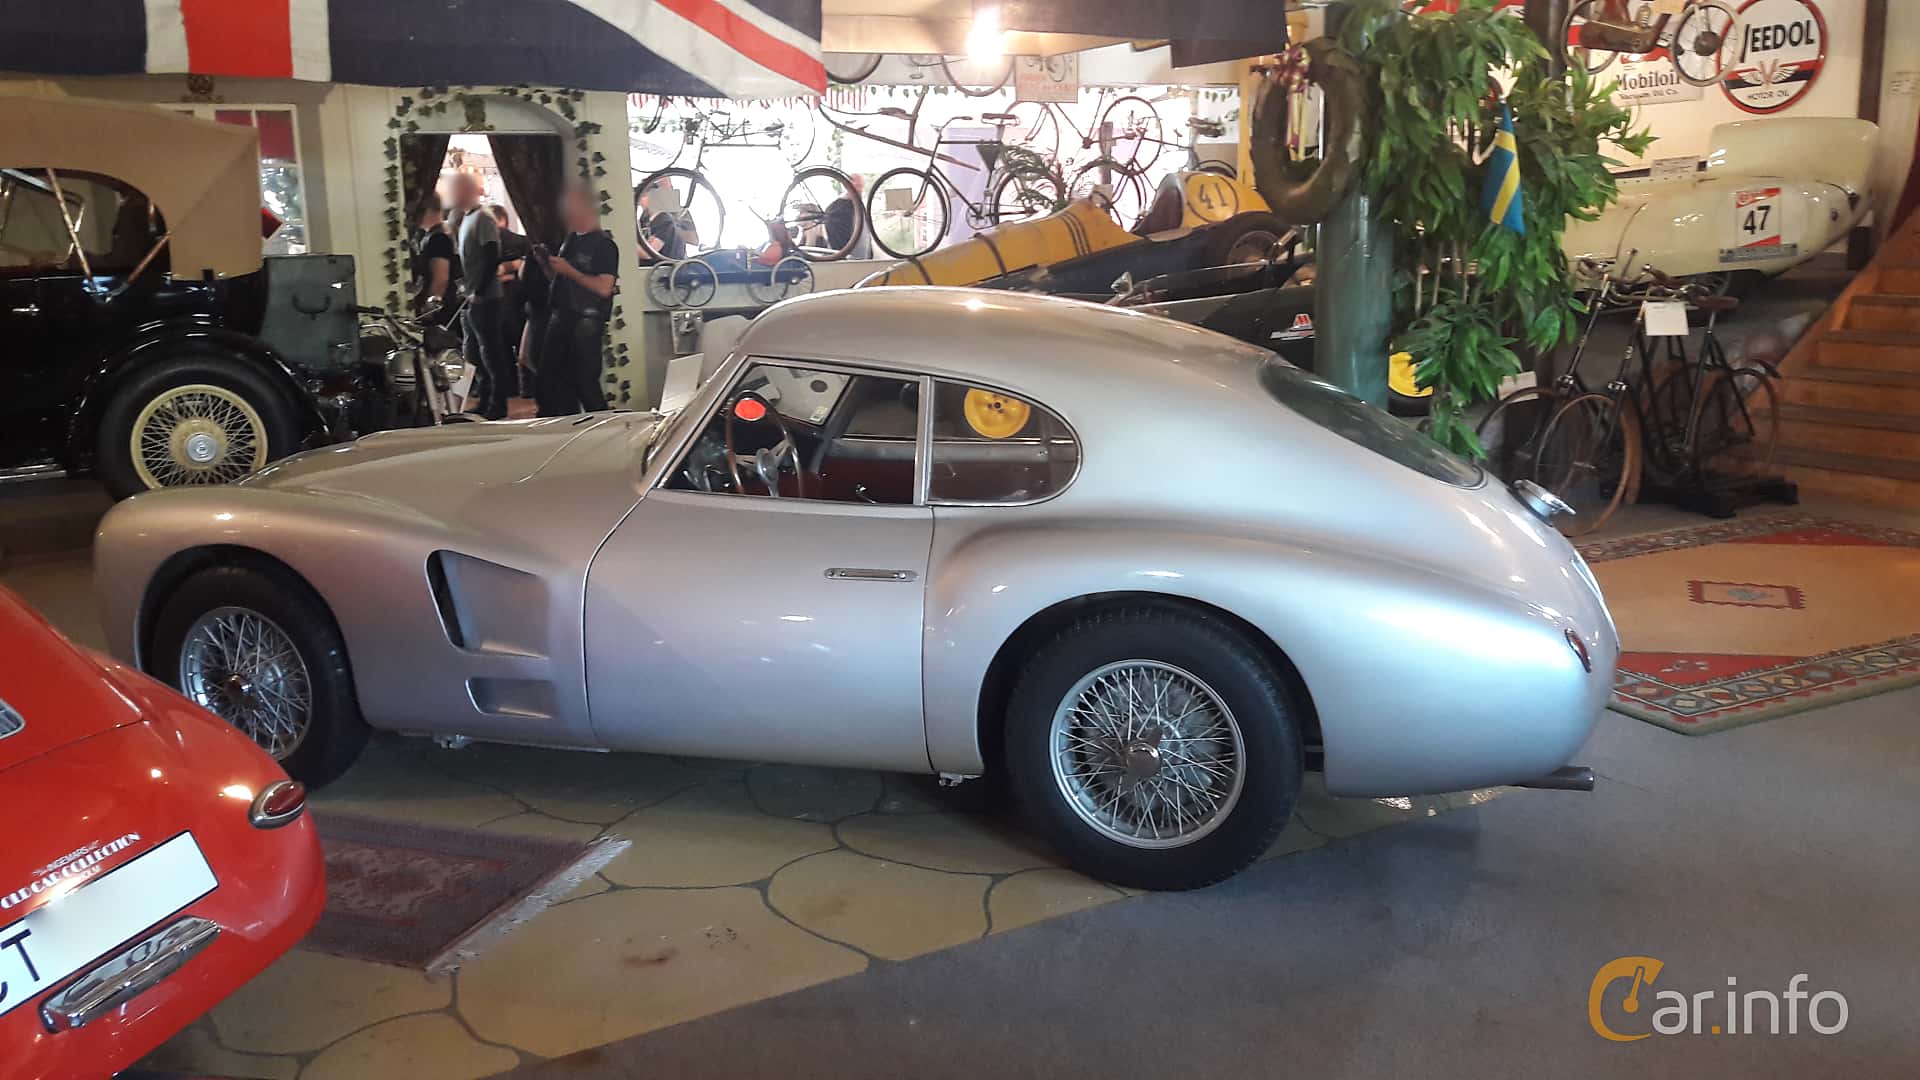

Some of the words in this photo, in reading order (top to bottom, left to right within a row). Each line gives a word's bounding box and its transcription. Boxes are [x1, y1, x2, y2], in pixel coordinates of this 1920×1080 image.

[1198, 182, 1228, 209] 41
[1743, 205, 1772, 235] 47
[0, 887, 32, 909] OLD
[61, 832, 141, 878] COLLECTION
[0, 928, 40, 1002] T
